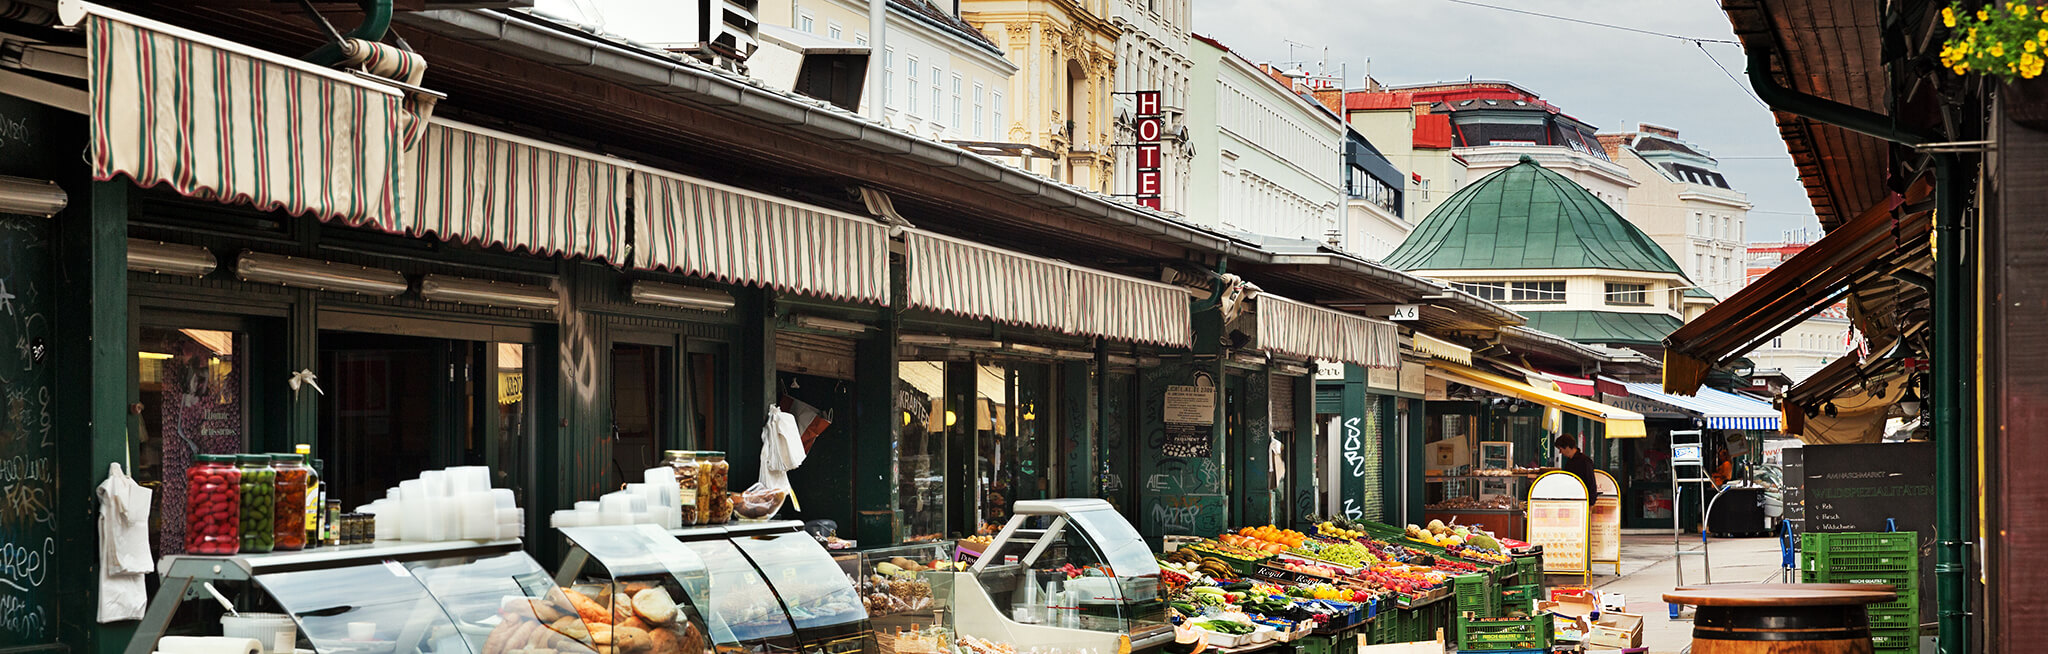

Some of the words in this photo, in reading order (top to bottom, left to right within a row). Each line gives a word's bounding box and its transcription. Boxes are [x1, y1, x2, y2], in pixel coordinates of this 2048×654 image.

[1394, 308, 1403, 318] A
[1407, 307, 1414, 318] 6
[1257, 567, 1285, 579] Royal
